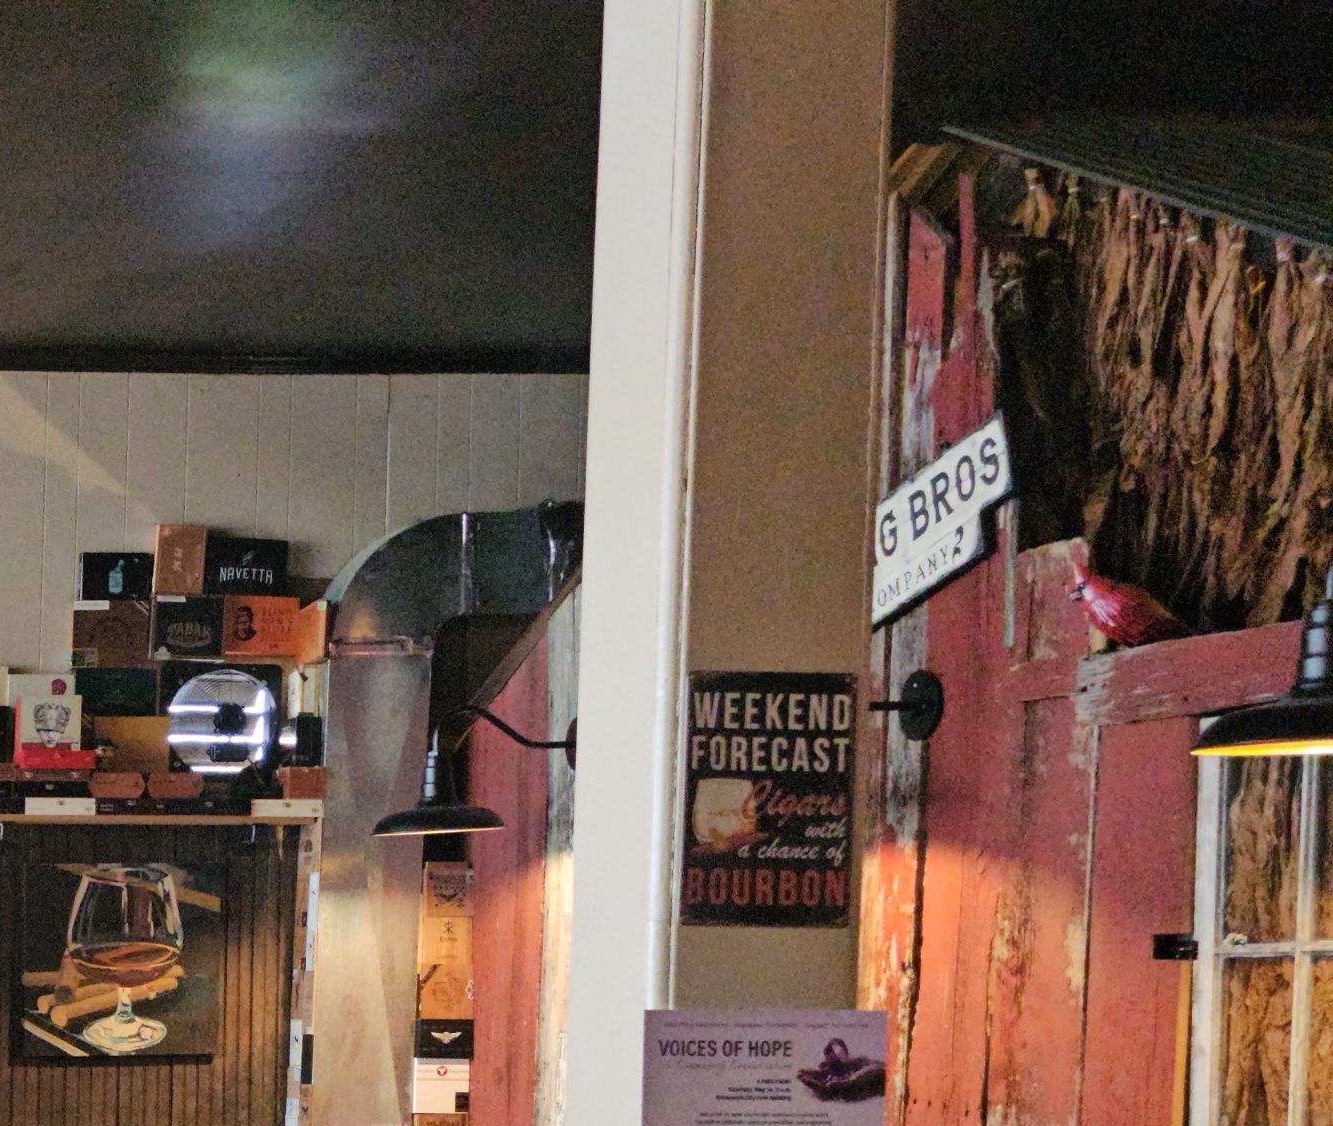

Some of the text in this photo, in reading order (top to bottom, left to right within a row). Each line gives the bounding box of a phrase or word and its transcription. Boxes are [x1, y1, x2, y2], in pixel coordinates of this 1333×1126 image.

[908, 437, 1000, 541] BROS
[219, 566, 273, 584] NAVETTA
[876, 545, 950, 607] OMPANY
[694, 691, 852, 731] WEEKEND
[691, 735, 850, 772] FORECAST
[741, 779, 846, 827] Cigars
[804, 818, 846, 839] with
[737, 837, 847, 867] a chance of
[686, 867, 845, 907] BOURBON
[658, 1040, 792, 1057] VOICES OF HOPE
